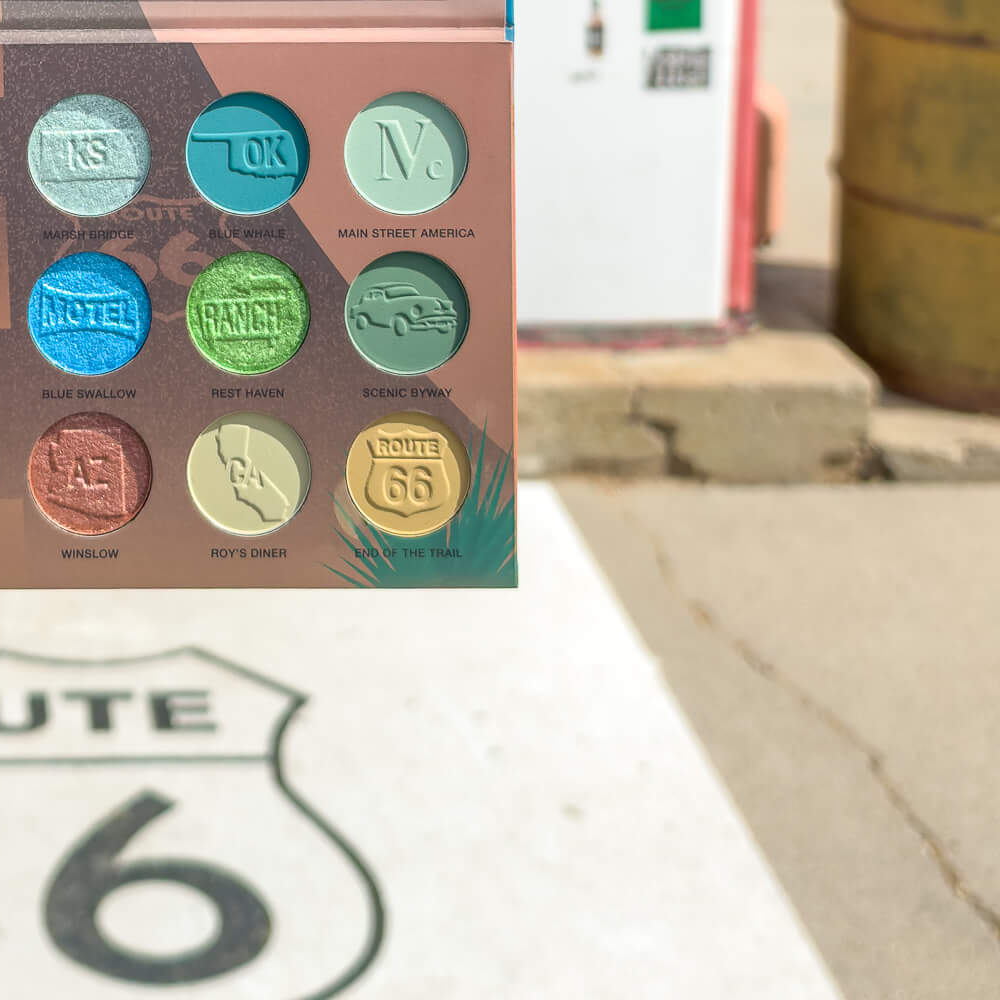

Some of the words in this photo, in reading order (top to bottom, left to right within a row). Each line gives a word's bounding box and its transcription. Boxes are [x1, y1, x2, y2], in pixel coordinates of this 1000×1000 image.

[66, 137, 108, 171] KS
[242, 136, 287, 169] OK
[43, 231, 86, 241] MARSH
[89, 230, 135, 240] BRIDGE
[208, 229, 241, 240] BLUE
[243, 229, 286, 239] WHALE
[338, 228, 368, 239] MAIN
[371, 228, 417, 239] STREET
[420, 228, 476, 239] AMERICA
[42, 296, 136, 329] MOTEL
[202, 300, 281, 337] RANCH
[42, 389, 73, 400] BLUE
[76, 389, 137, 399] SWALLOW
[211, 388, 241, 399] REST
[245, 388, 285, 399] HAVEN
[362, 388, 407, 399] SCENIC
[410, 387, 453, 398] BYWAY
[376, 438, 441, 456] ROUTE
[67, 456, 109, 489] AZ
[228, 456, 264, 489] CA
[384, 465, 433, 506] 66
[61, 549, 119, 559] WINSLOW
[211, 548, 247, 558] ROY'S
[251, 548, 287, 558] DINER
[354, 548, 380, 558] END
[383, 548, 398, 558] OF
[403, 548, 425, 558] THE
[429, 548, 463, 558] TRAIL
